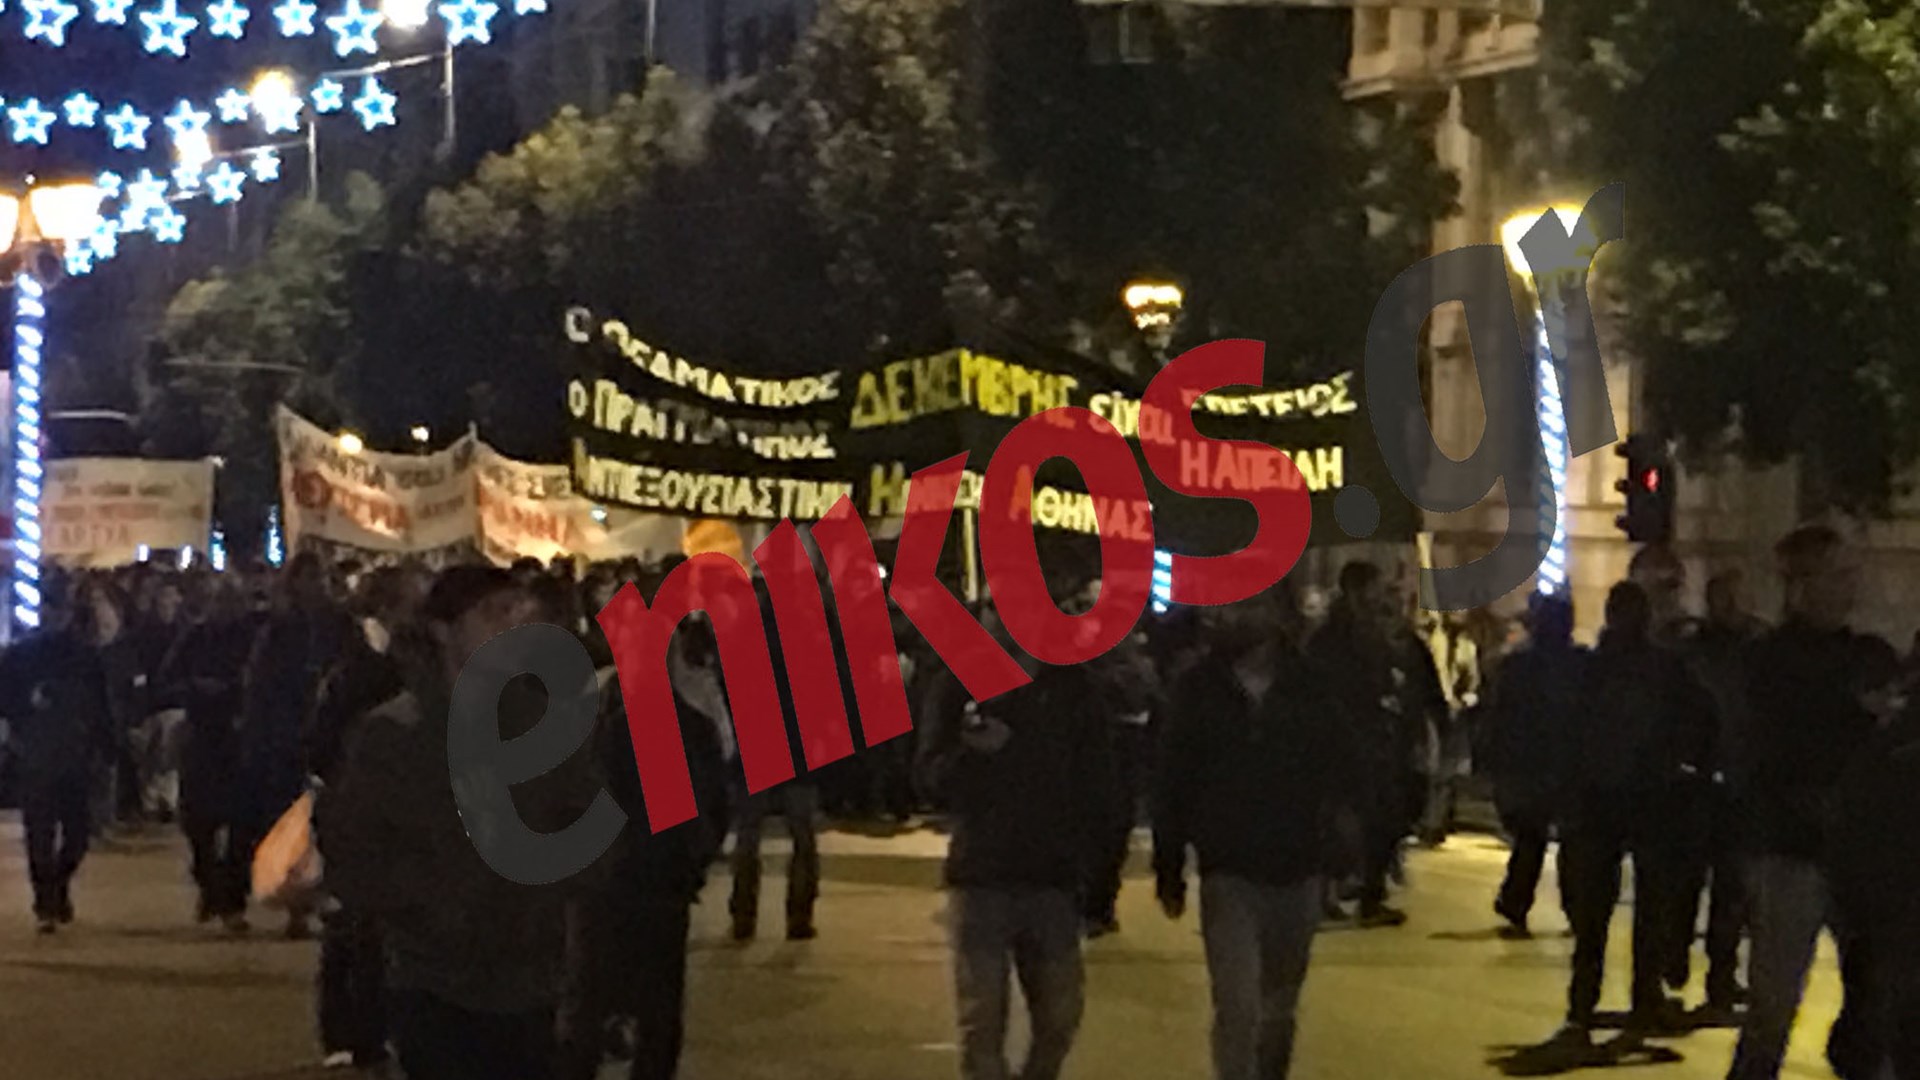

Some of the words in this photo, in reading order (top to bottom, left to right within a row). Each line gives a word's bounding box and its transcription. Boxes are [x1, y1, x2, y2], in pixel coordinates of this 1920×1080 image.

[1180, 439, 1209, 488] Η
[1212, 442, 1343, 492] ΑΠΕΙΛΗ
[1008, 464, 1153, 541] ΑΘΗΝΑΣ
